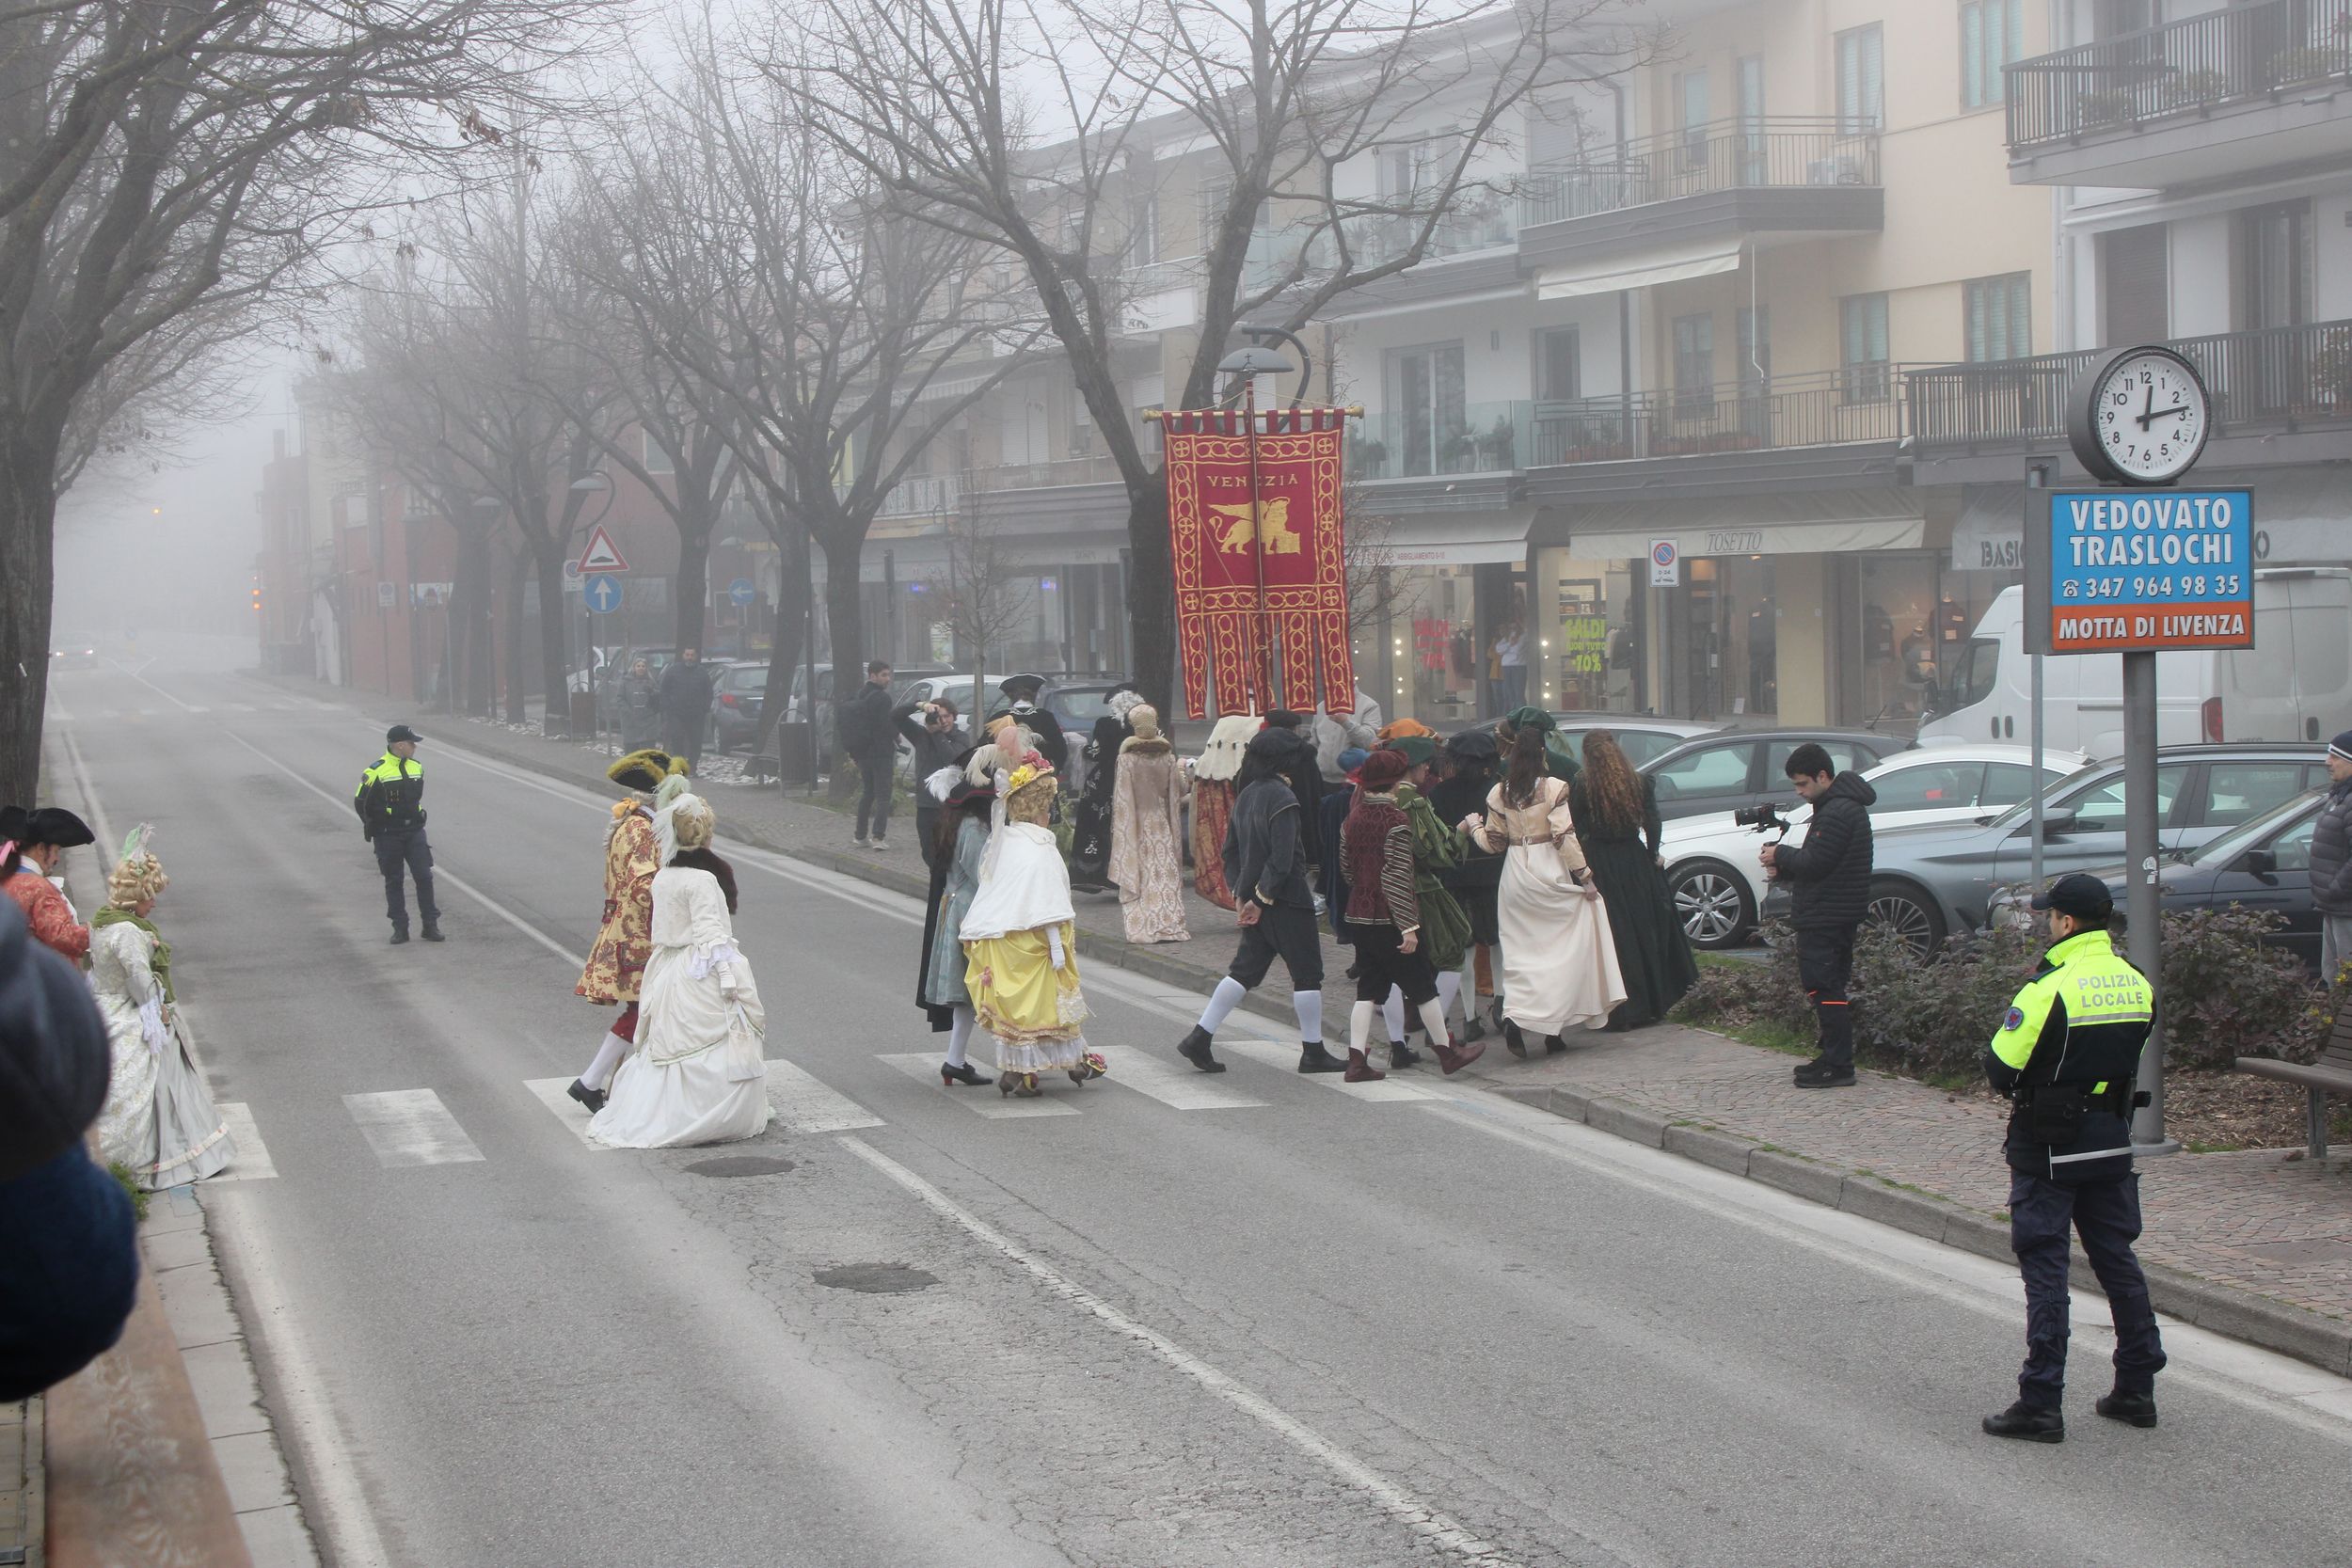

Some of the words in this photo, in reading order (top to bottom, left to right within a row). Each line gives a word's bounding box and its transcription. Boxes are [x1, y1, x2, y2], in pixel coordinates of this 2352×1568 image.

[2139, 372, 2152, 384] 12
[2124, 379, 2133, 390] 11
[2112, 393, 2128, 405] 10
[2172, 391, 2180, 404] 2
[2107, 412, 2115, 424] 9
[2179, 409, 2186, 421] 3
[2113, 432, 2121, 444] 8
[2173, 429, 2181, 441] 4
[2128, 445, 2135, 457] 7
[2161, 444, 2169, 455] 5
[2143, 450, 2151, 462] 6
[1206, 474, 1298, 487] VENZIA
[2070, 498, 2232, 531] VEDOVATO
[1708, 531, 1762, 551] TOSETTO
[2070, 533, 2232, 566] TRASLOCHI
[2085, 578, 2125, 597] 347
[2133, 577, 2172, 596] 964
[2181, 576, 2206, 595] 98
[2215, 575, 2239, 594] 35
[1565, 617, 1606, 639] SALDI
[2058, 617, 2127, 640] MOTTA
[2135, 616, 2154, 637] DI
[2163, 614, 2245, 637] LIVENZA
[2077, 974, 2140, 990] POLIZIA
[2081, 991, 2144, 1008] LOCALE
